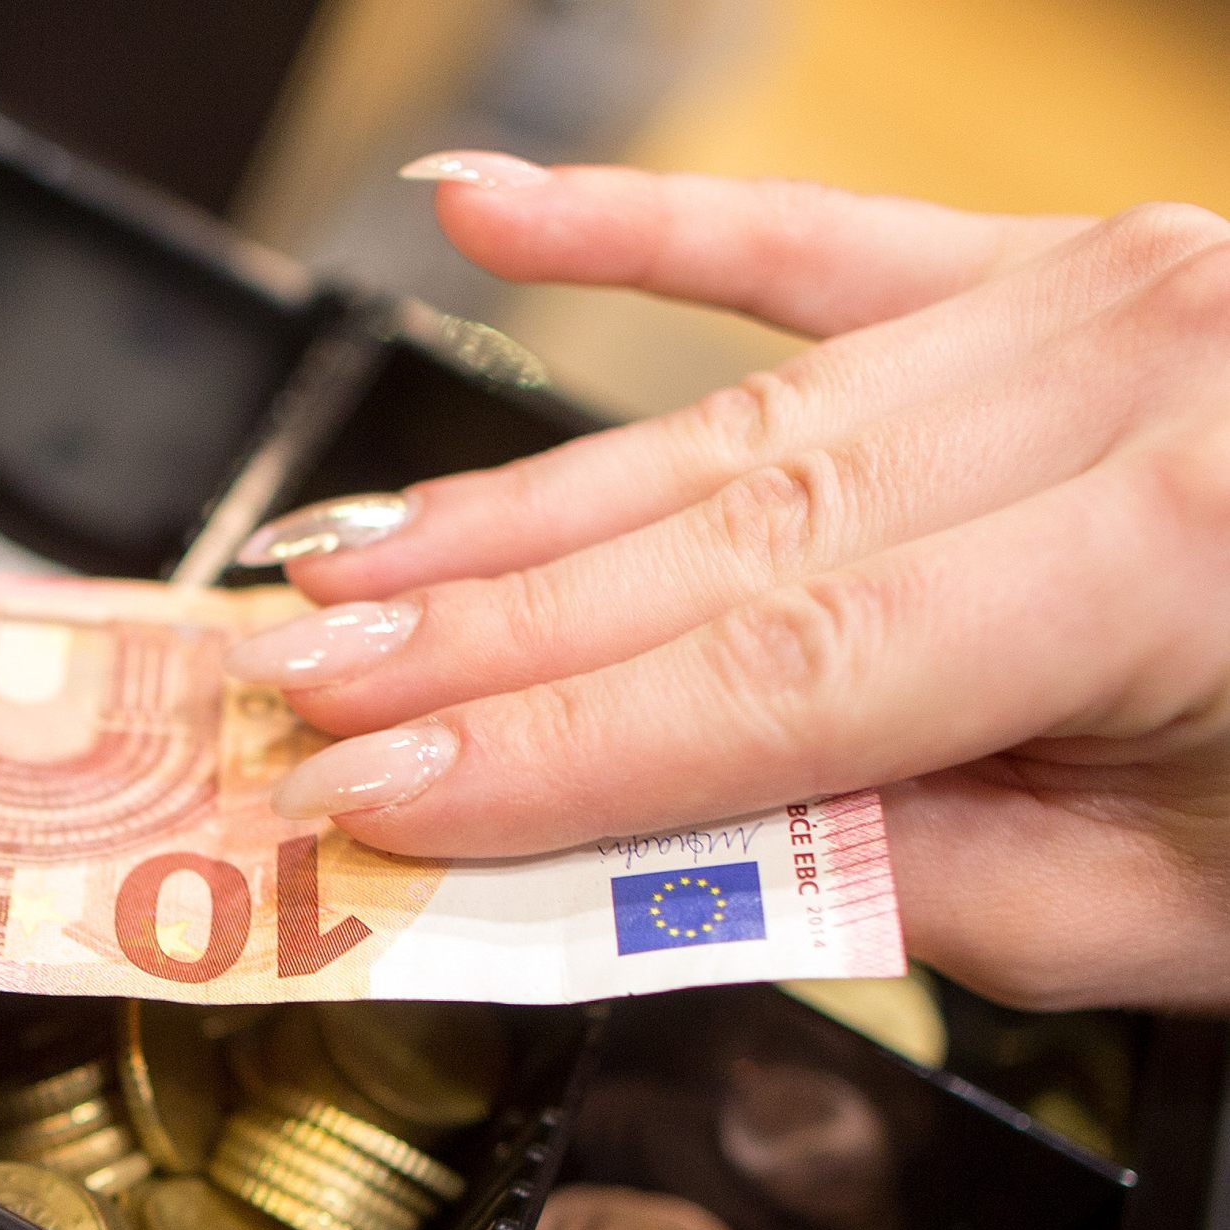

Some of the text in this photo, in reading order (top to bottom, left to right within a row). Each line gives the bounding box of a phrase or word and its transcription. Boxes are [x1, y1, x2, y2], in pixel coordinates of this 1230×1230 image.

[114, 833, 373, 984] 10
[793, 853, 820, 896] EBC
[807, 906, 827, 948] 2014
